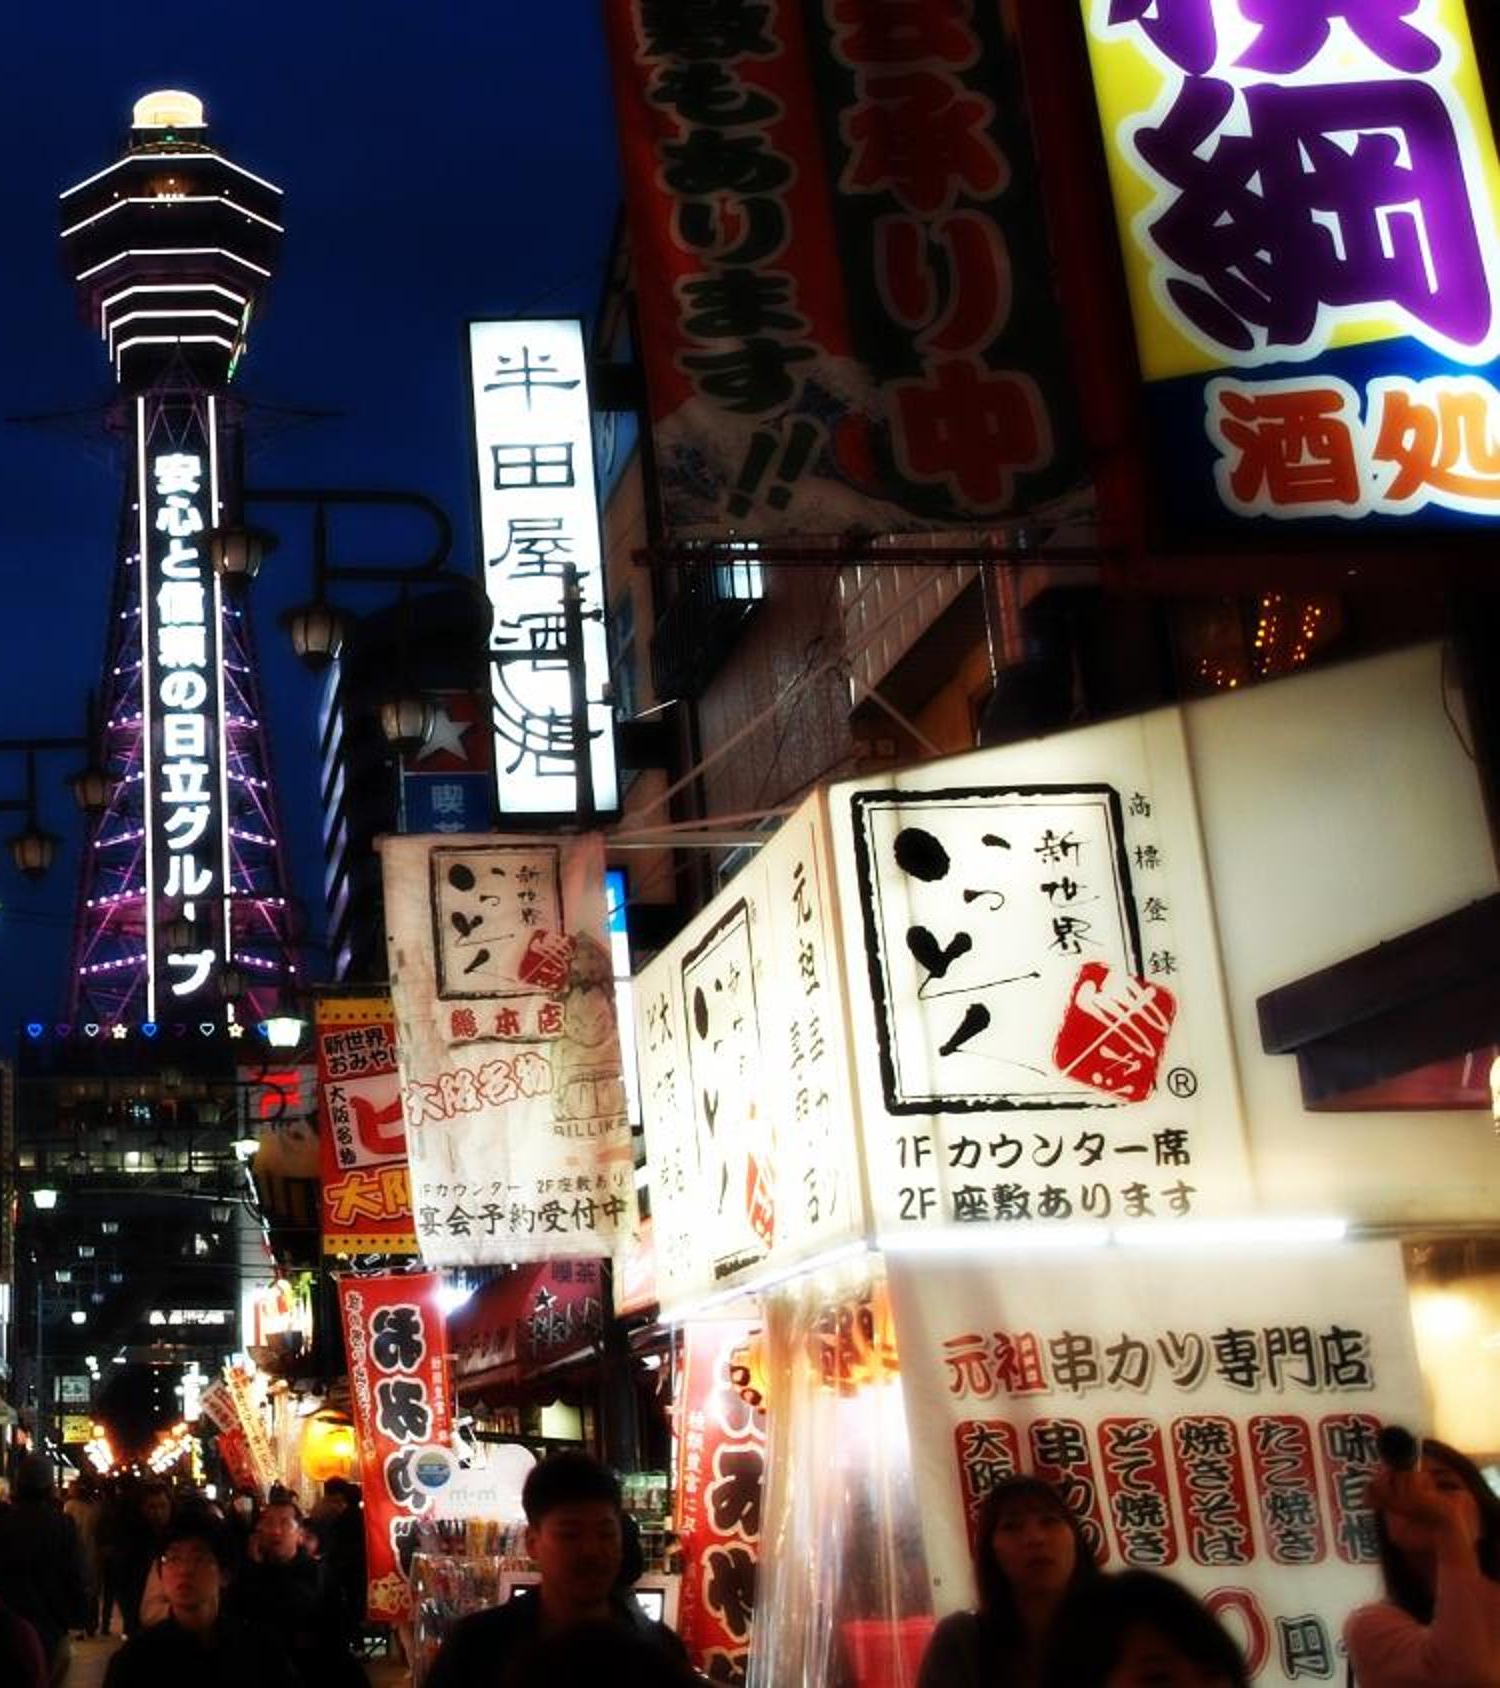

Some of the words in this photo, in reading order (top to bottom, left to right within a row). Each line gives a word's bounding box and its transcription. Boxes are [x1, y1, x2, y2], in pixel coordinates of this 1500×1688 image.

[154, 453, 215, 997] 安心と信頼の日立グルプ
[1034, 829, 1105, 956] 新世界
[1128, 793, 1178, 977] 商標登録
[323, 1028, 387, 1056] 新世界
[897, 1135, 932, 1169] 1F
[948, 1128, 1192, 1170] カウンター席
[899, 1187, 938, 1221] 2F
[953, 1182, 1197, 1225] 座敷あります
[419, 1194, 629, 1237] 宴会予約受付中
[941, 1325, 1372, 1394] 元祖串カツ専門店
[1106, 1422, 1168, 1566] どて焼き
[1180, 1418, 1248, 1564] 焼きそば
[1257, 1418, 1319, 1562] たこ焼き
